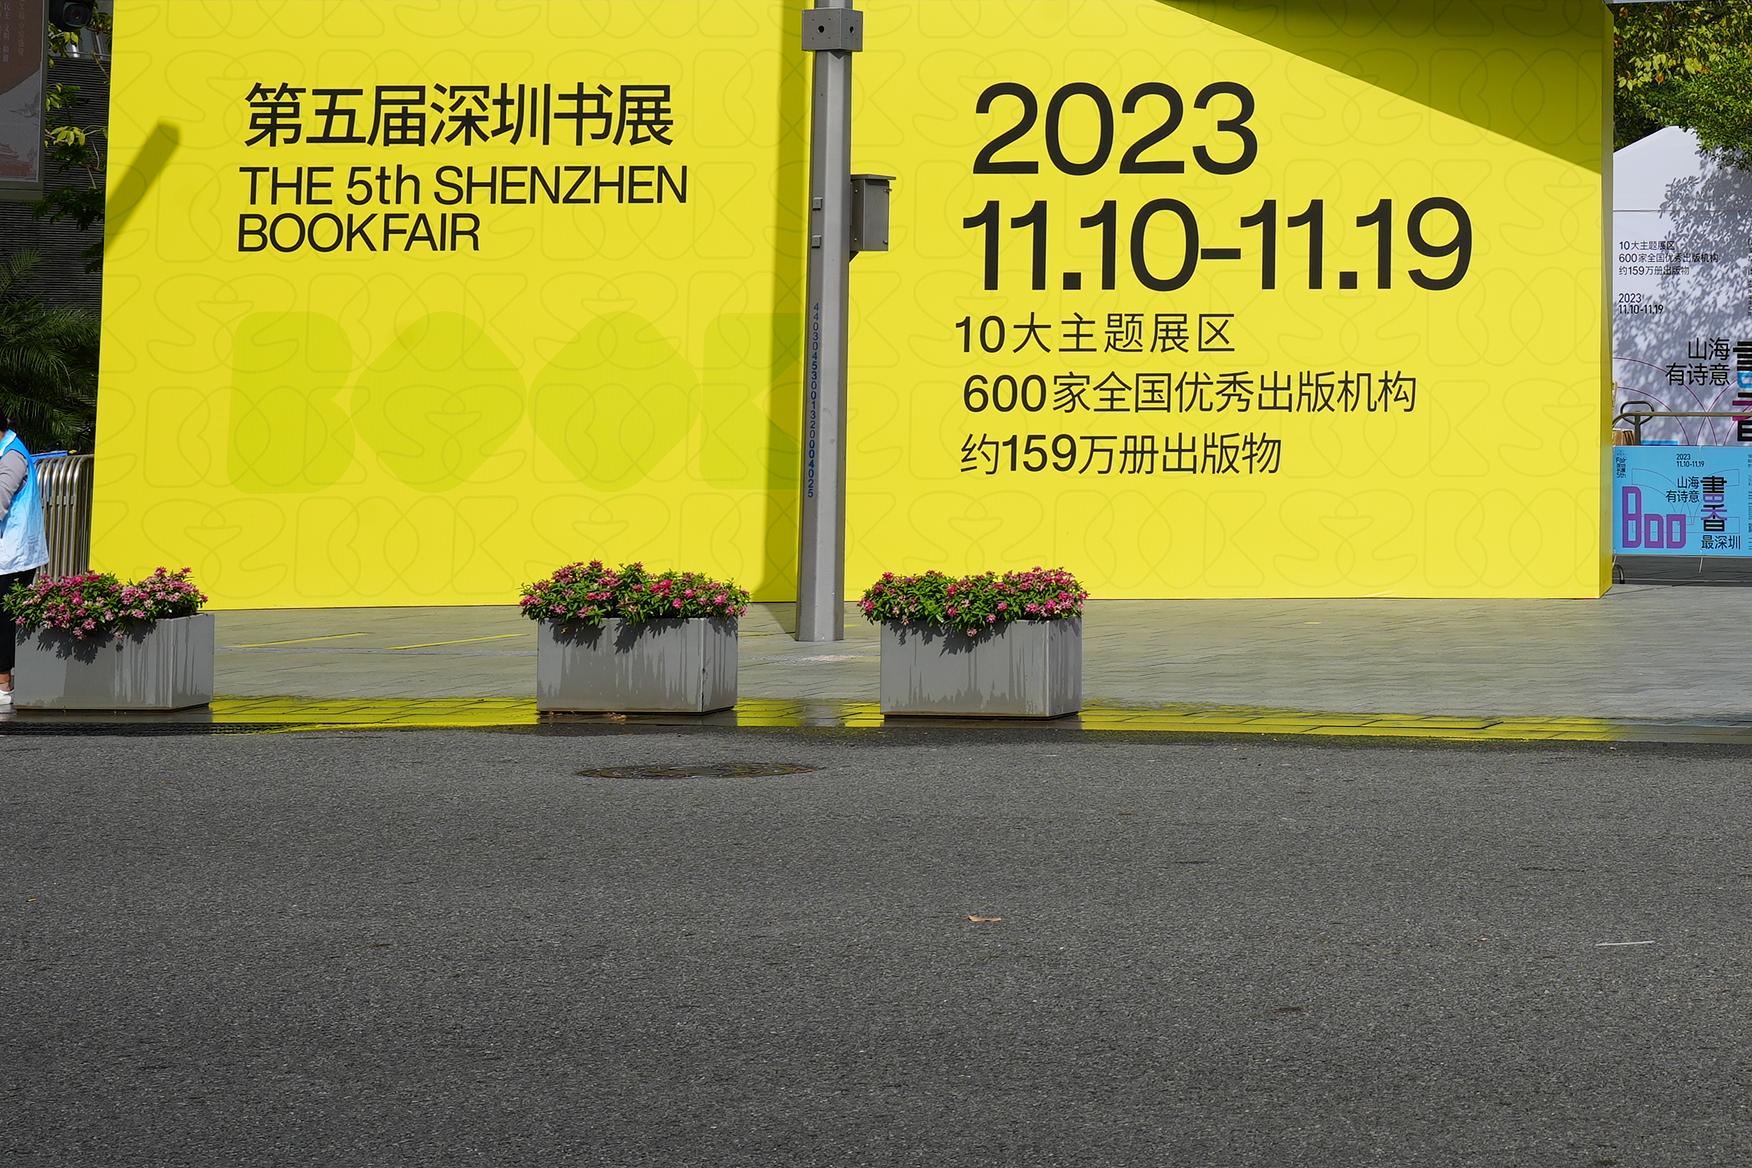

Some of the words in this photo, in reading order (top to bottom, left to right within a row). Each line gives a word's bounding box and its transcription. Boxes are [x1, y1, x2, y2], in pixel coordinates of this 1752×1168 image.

[244, 81, 674, 147] 第五届深圳书展
[972, 81, 1258, 176] 2023
[239, 166, 333, 205] THE
[346, 164, 420, 205] 5th
[433, 165, 688, 205] SHENZHEN
[962, 196, 1473, 292] 11.10-11.19
[1618, 240, 1676, 252] 10大主题展区
[1618, 253, 1719, 264] 600家全国优秀出版机构
[1618, 265, 1690, 276] 约159万册出版物
[1618, 293, 1642, 304] 2023
[1618, 305, 1664, 315] 11.10-11.19
[955, 311, 1235, 353] 10大主题展区
[1688, 337, 1731, 360] 山海
[1665, 362, 1731, 386] 有诗意
[963, 370, 1416, 413] 600家全国优秀出版机构
[960, 432, 1282, 475] 约159万册出版物
[1677, 476, 1700, 489] 山海
[1666, 490, 1700, 503] 有诗意
[1701, 535, 1741, 550] 最深圳
